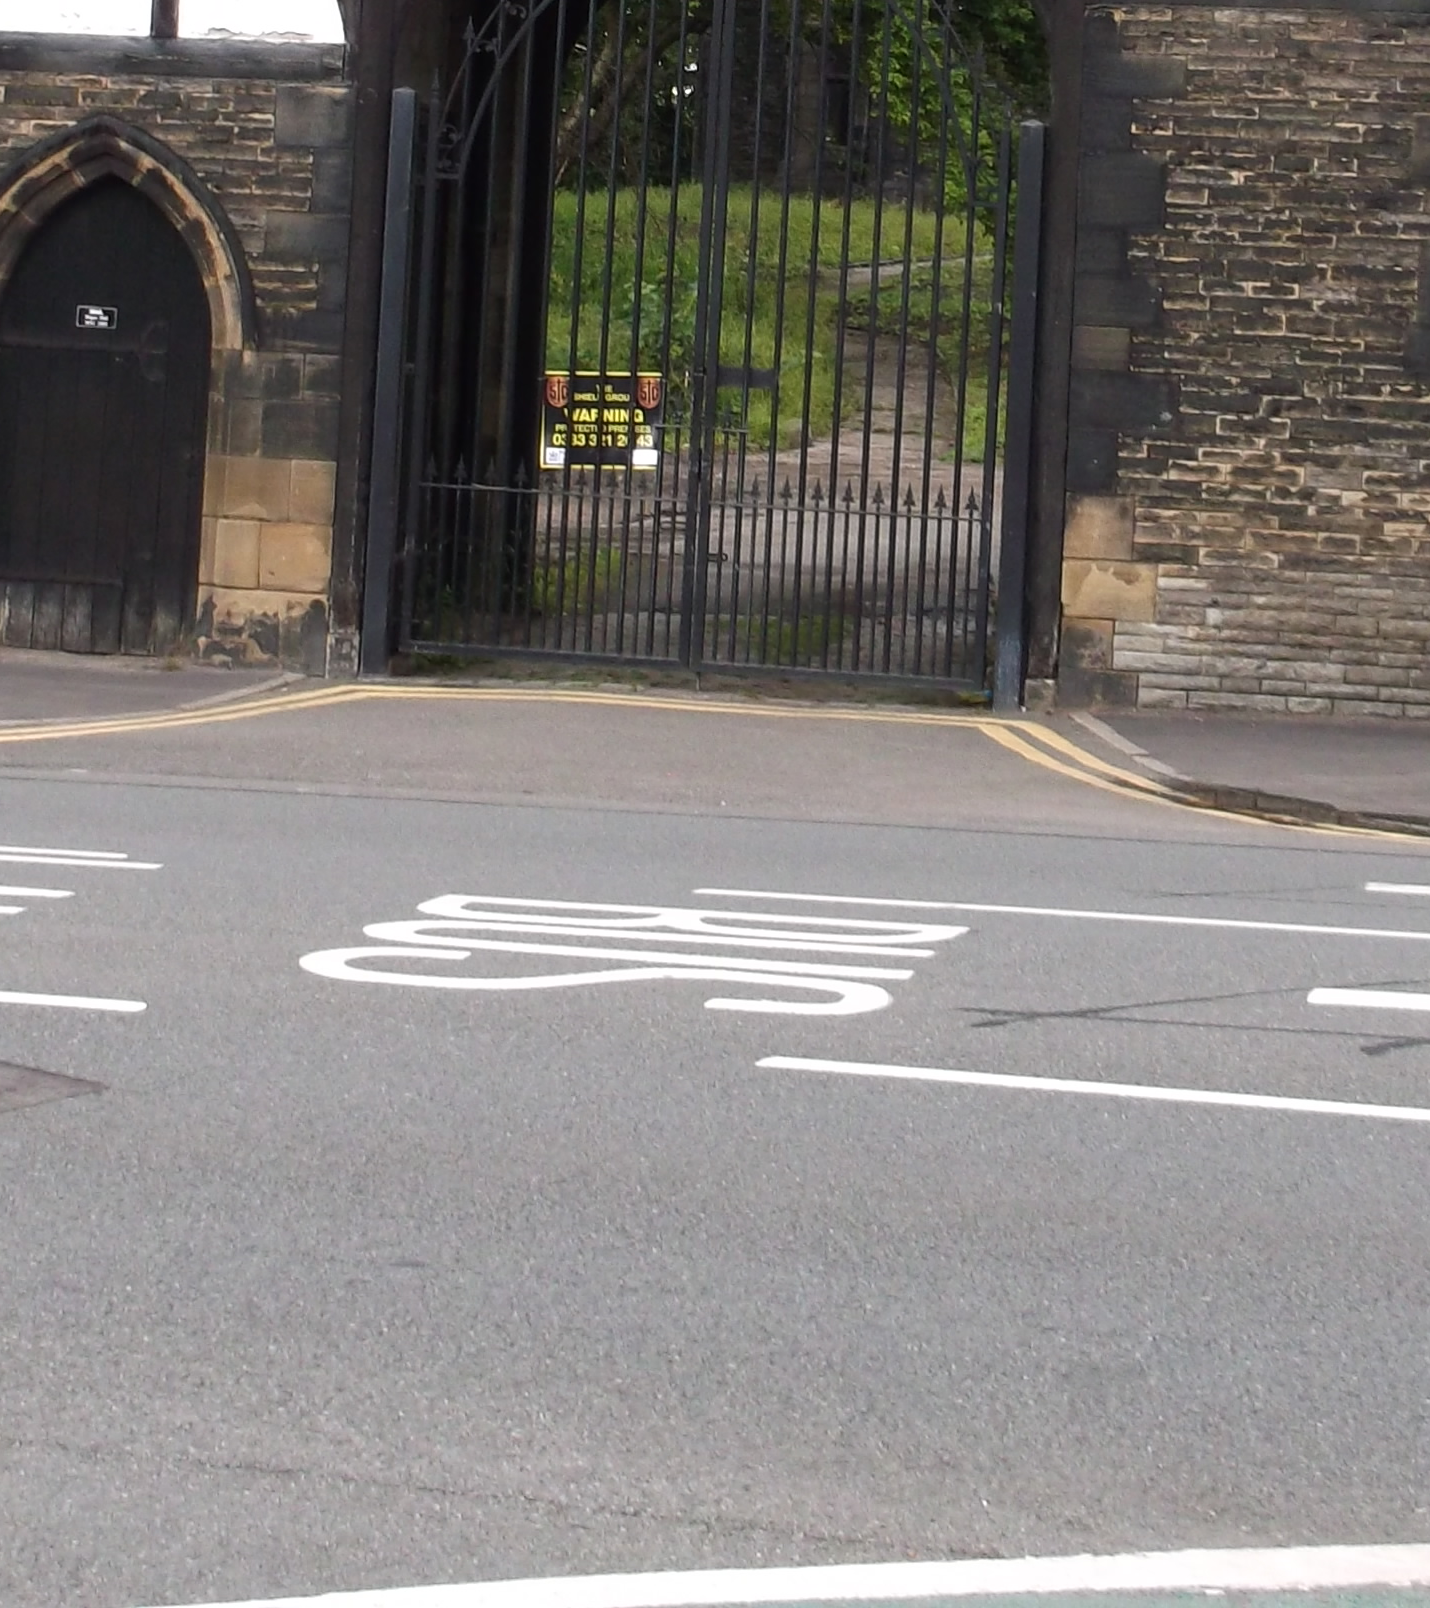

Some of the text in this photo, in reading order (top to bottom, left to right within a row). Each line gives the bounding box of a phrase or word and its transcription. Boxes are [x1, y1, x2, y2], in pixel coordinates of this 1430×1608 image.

[573, 393, 630, 401] SHIEL GROU
[636, 435, 653, 447] 43
[300, 894, 969, 1015] BUS
